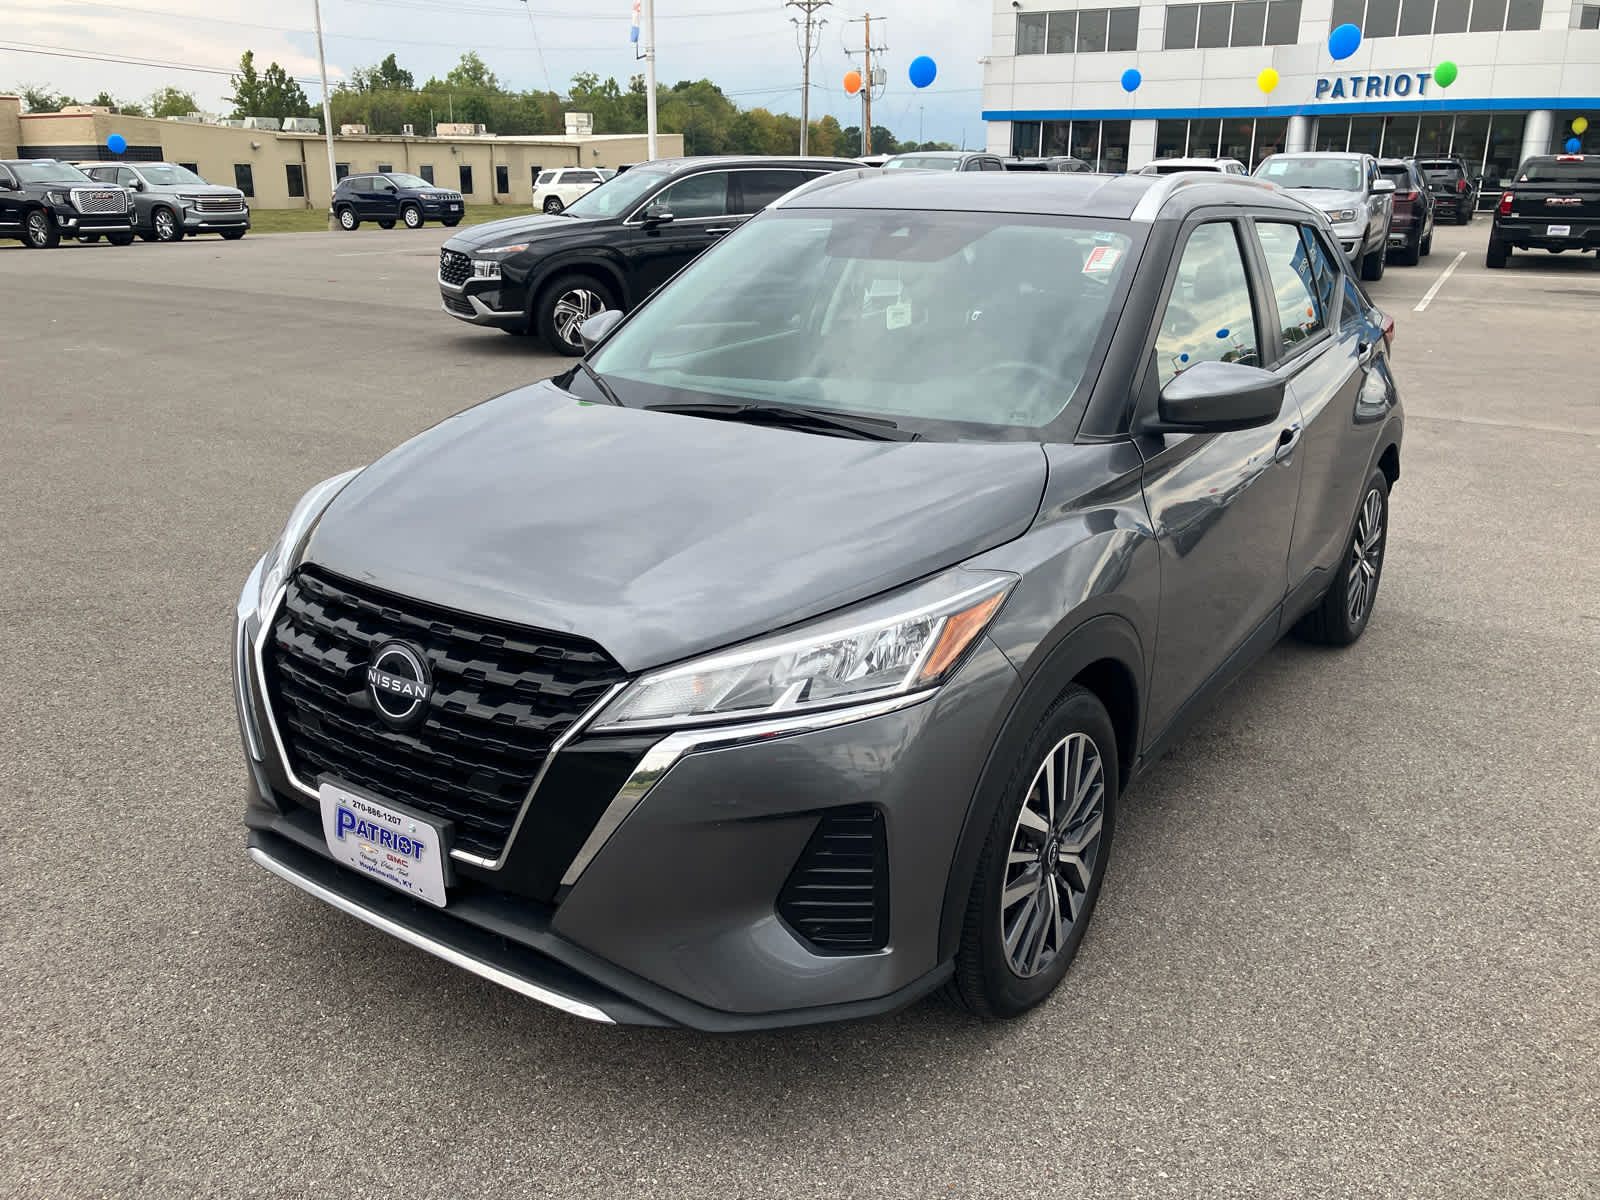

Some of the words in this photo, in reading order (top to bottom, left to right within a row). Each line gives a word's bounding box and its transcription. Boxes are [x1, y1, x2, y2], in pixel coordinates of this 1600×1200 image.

[1315, 73, 1431, 98] PATRIOT
[368, 670, 426, 698] NISSAN
[352, 800, 401, 825] 270-886-1207
[336, 806, 424, 860] PATRIOT
[386, 853, 408, 868] GMC
